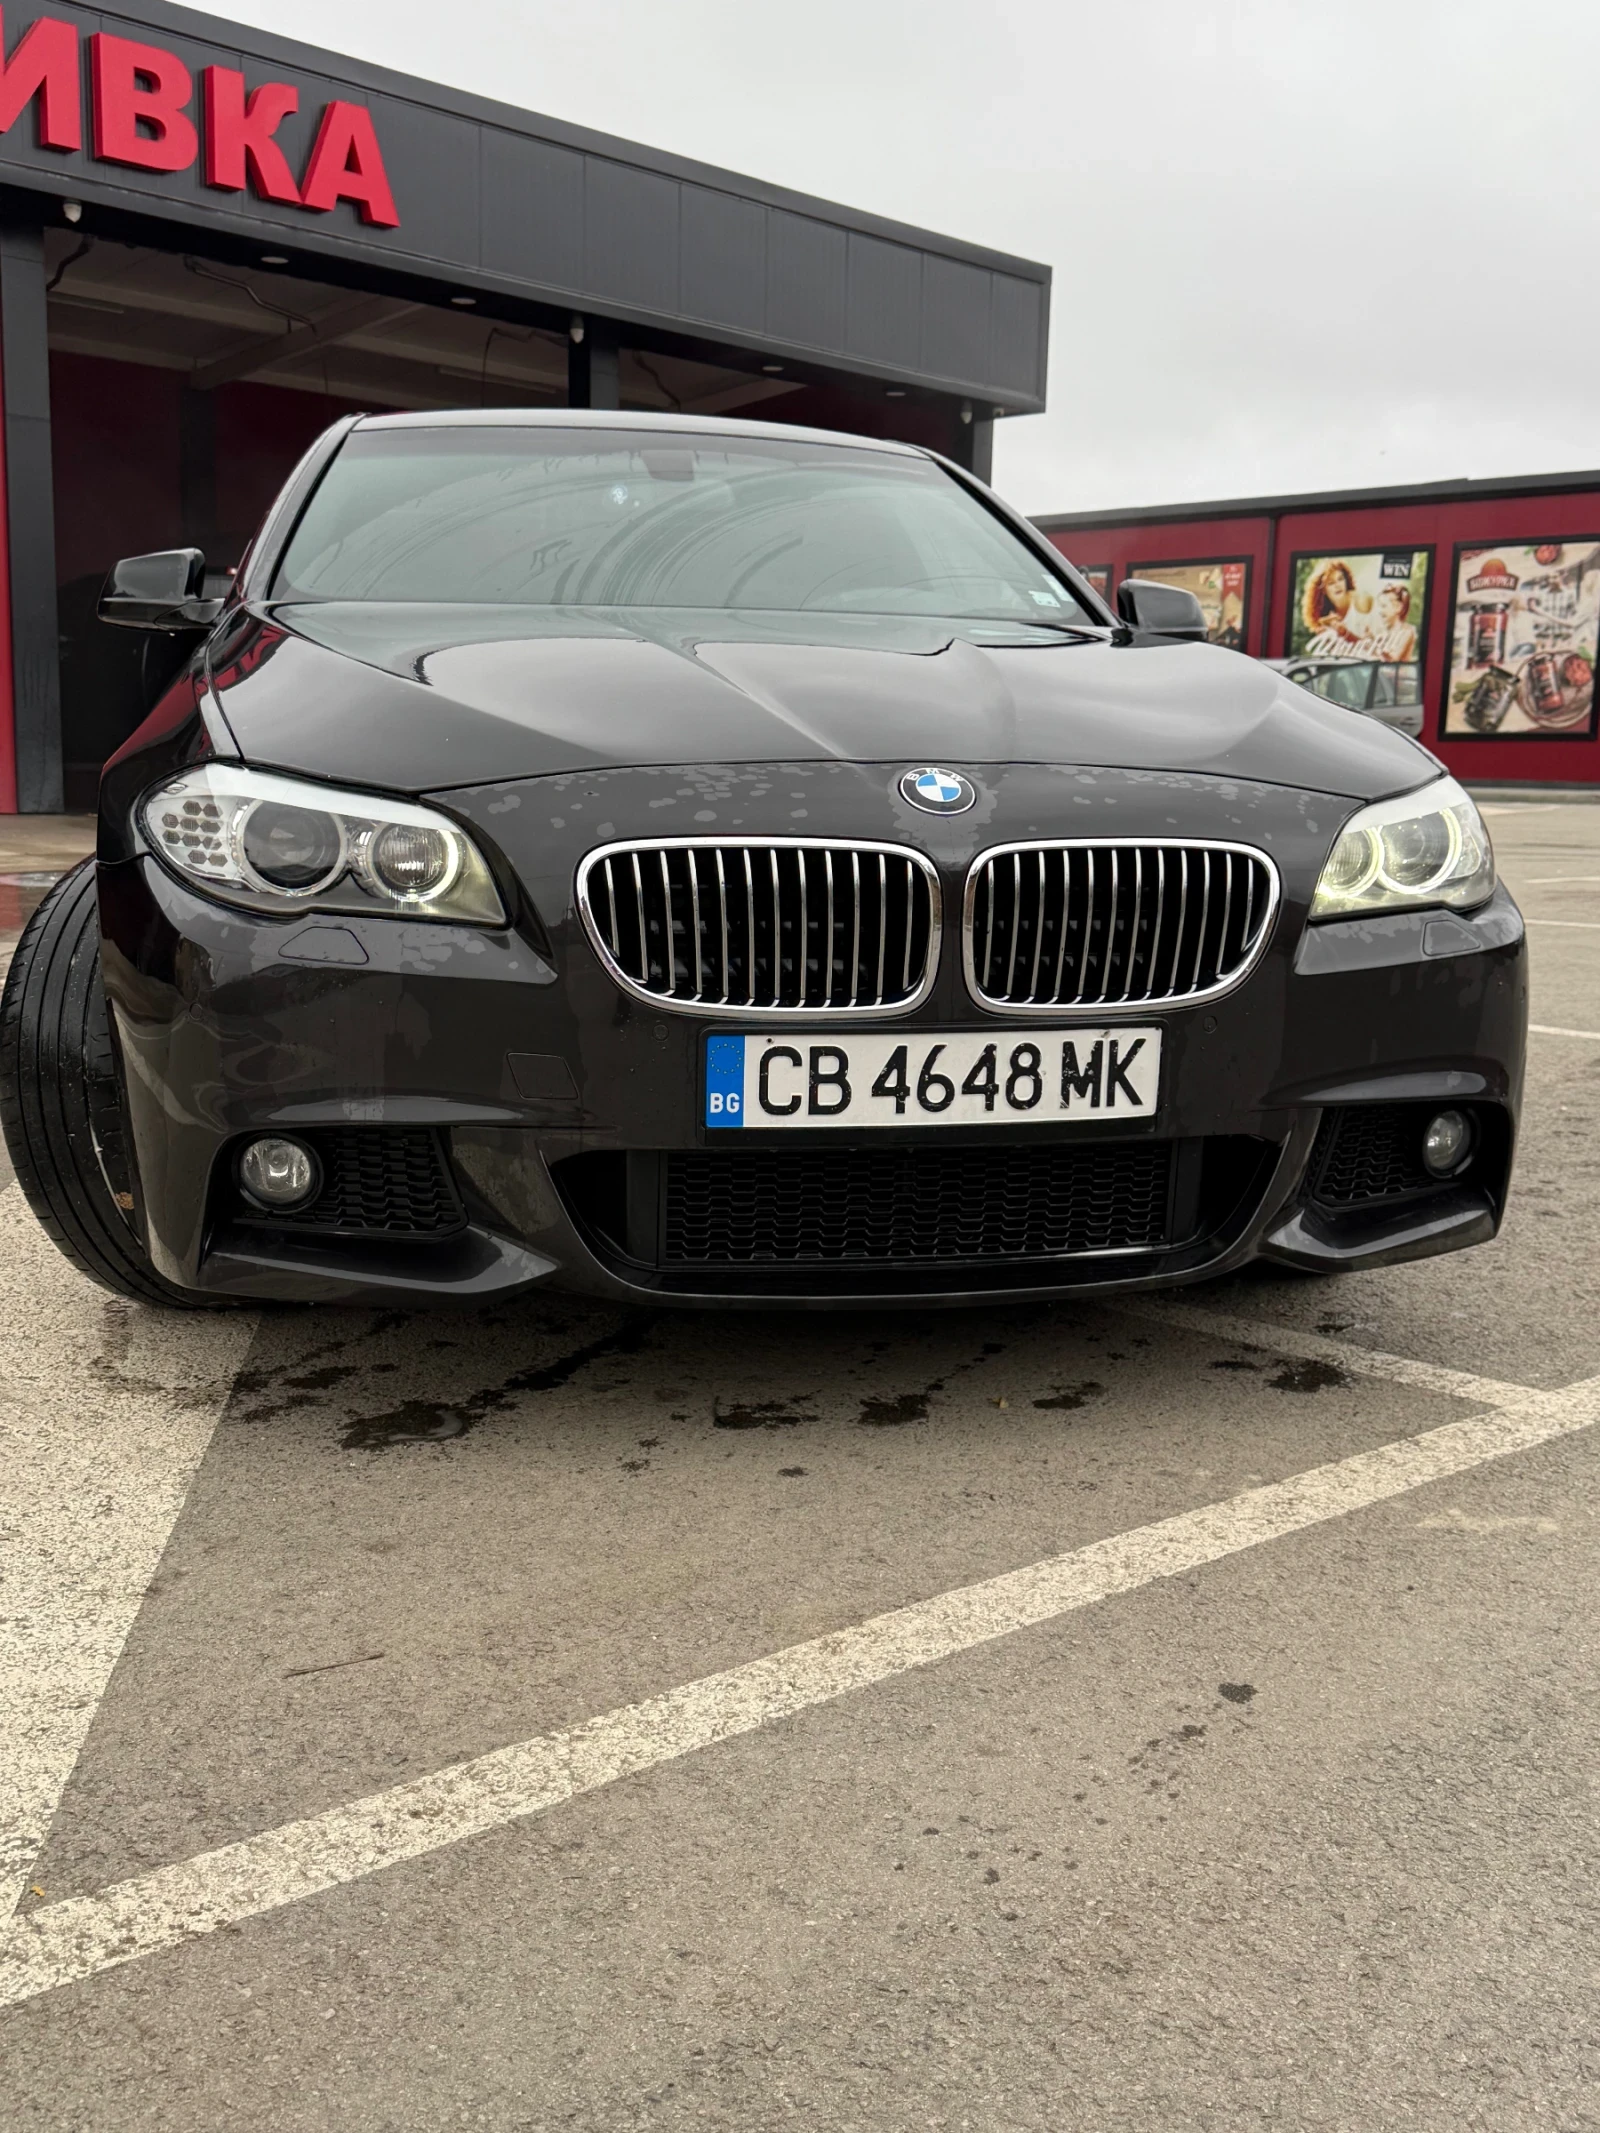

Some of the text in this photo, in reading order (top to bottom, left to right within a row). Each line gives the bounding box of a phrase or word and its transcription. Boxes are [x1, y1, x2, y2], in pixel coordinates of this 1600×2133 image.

[906, 768, 964, 781] BMW
[758, 1038, 1147, 1115] CB 4648 MK
[709, 1093, 740, 1114] BG
